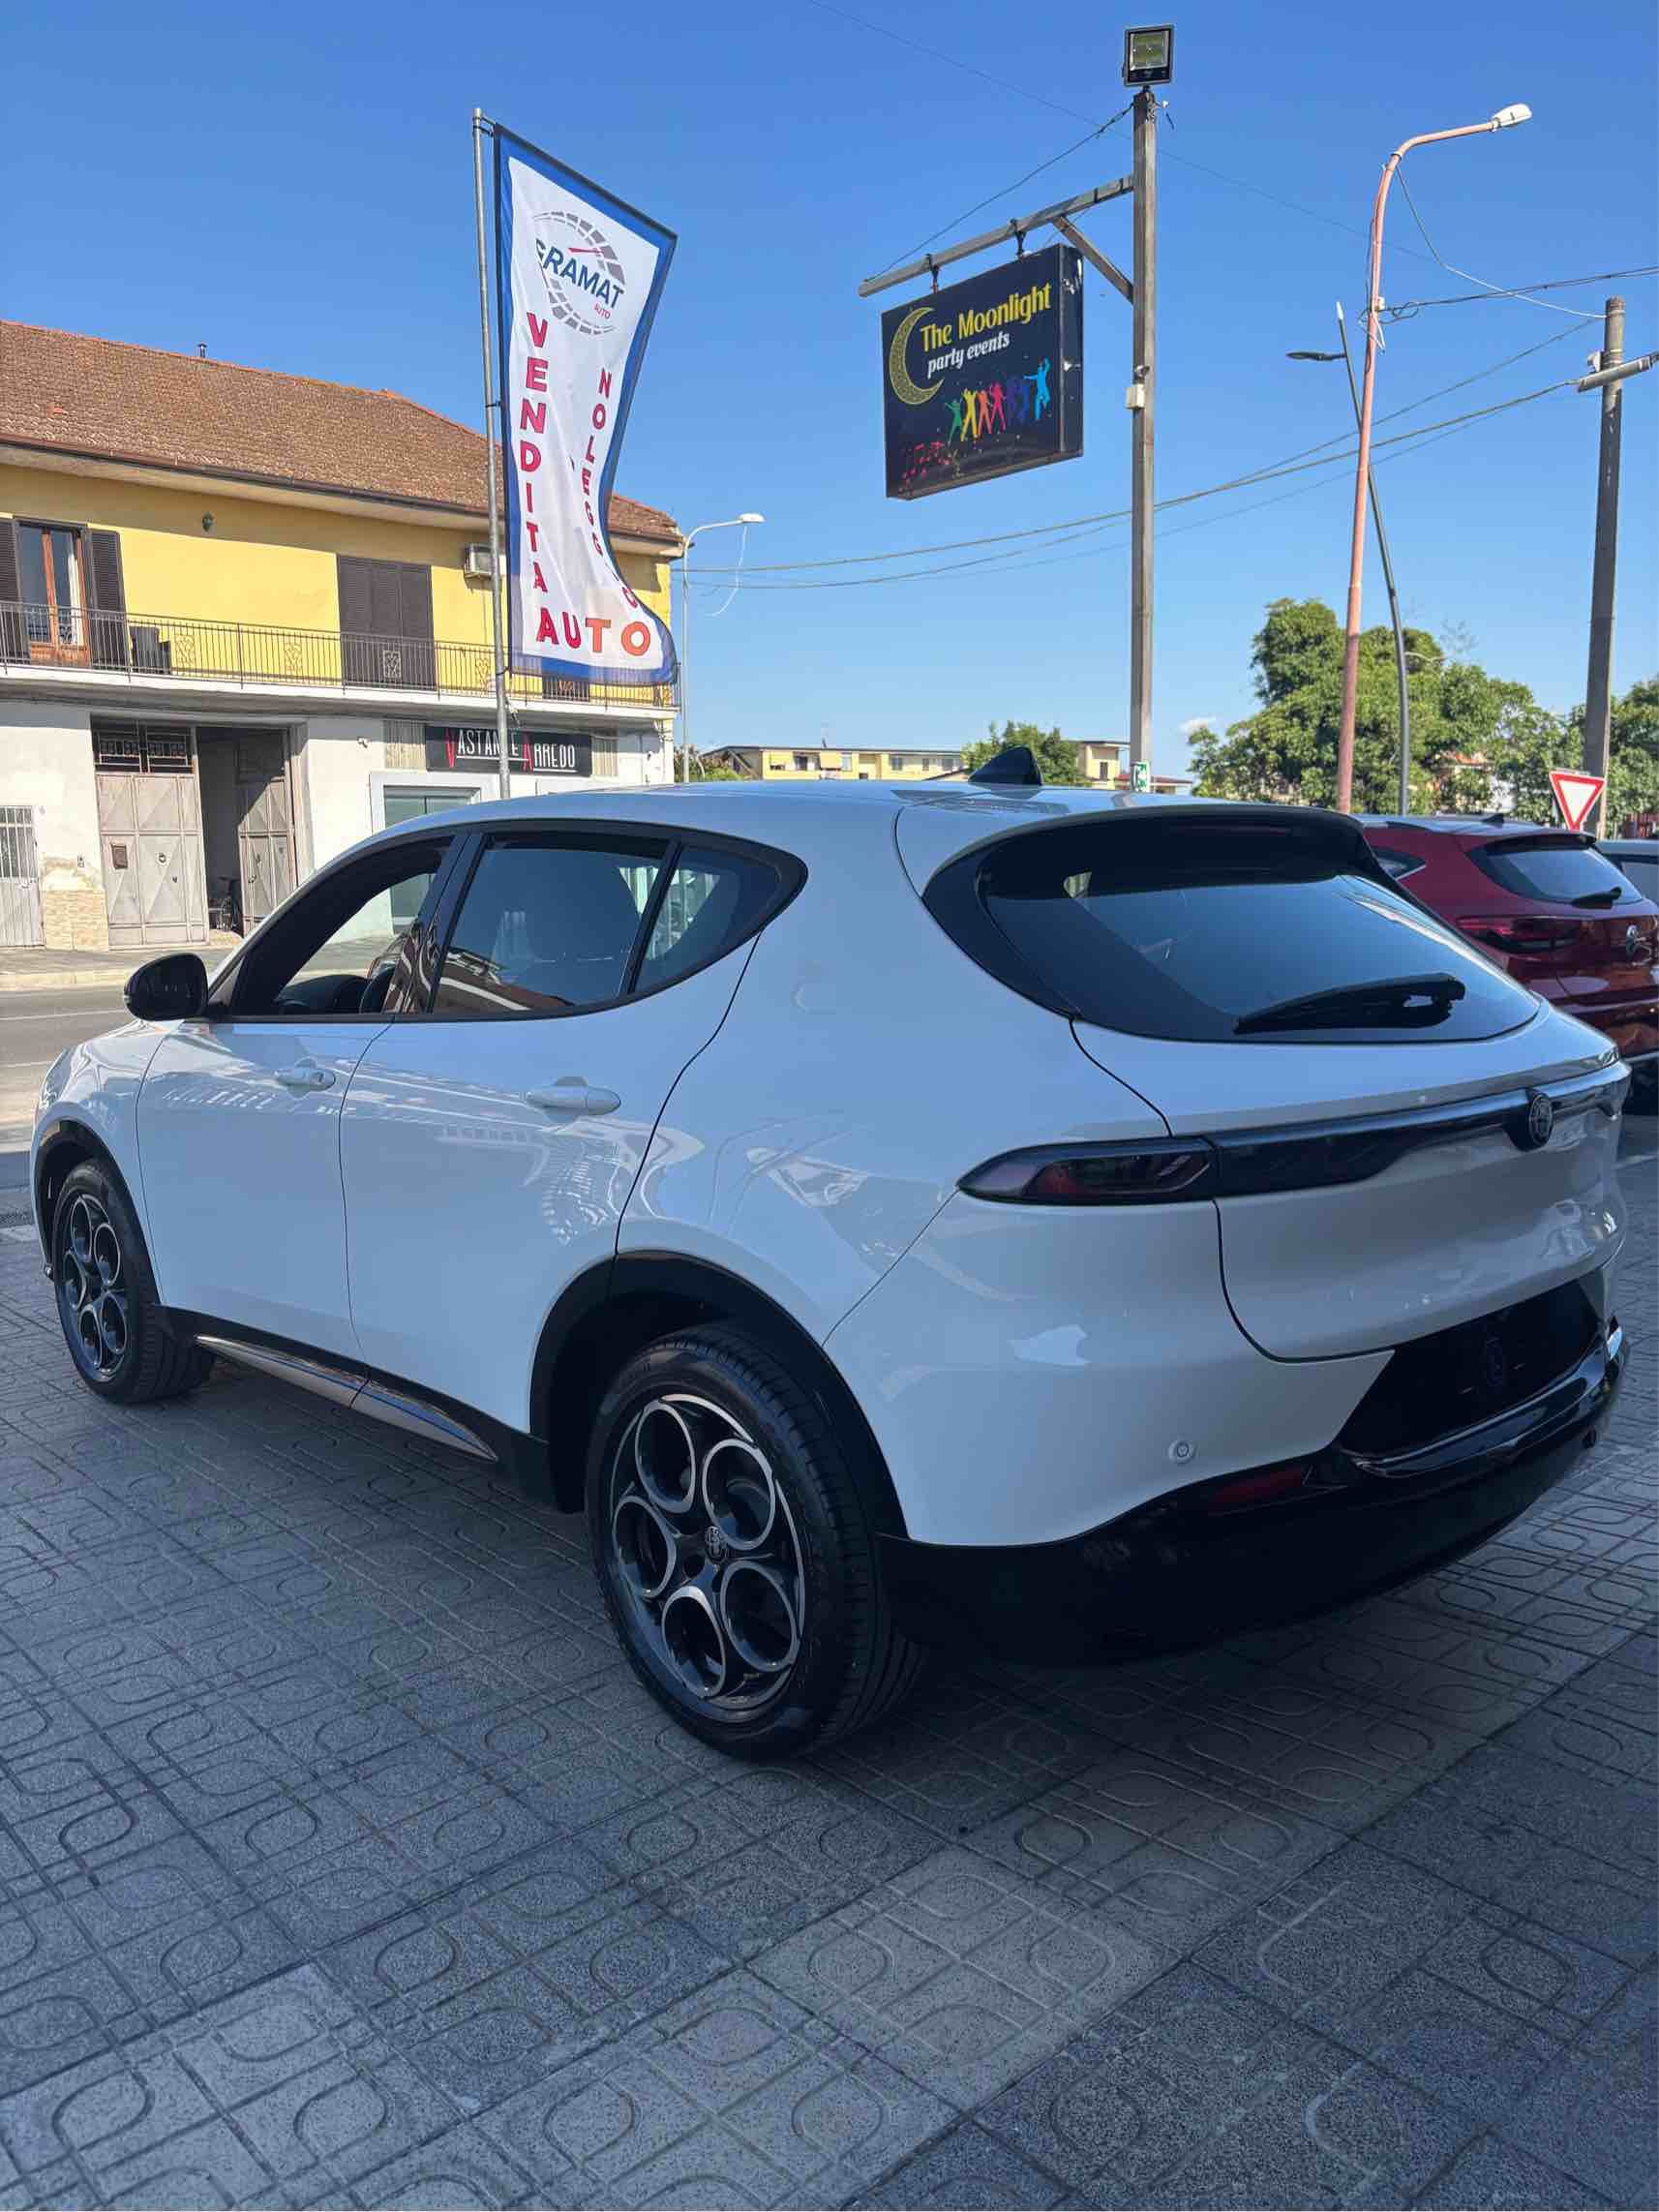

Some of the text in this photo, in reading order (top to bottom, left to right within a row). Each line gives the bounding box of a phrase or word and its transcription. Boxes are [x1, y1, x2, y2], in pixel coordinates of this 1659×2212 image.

[593, 302, 611, 319] AUTO
[920, 282, 1052, 352] The Moonlight
[927, 330, 1010, 379] party events
[520, 312, 549, 593] VENDITA
[535, 607, 651, 657] AUTO
[445, 728, 576, 773] VASTANE ARREDO
